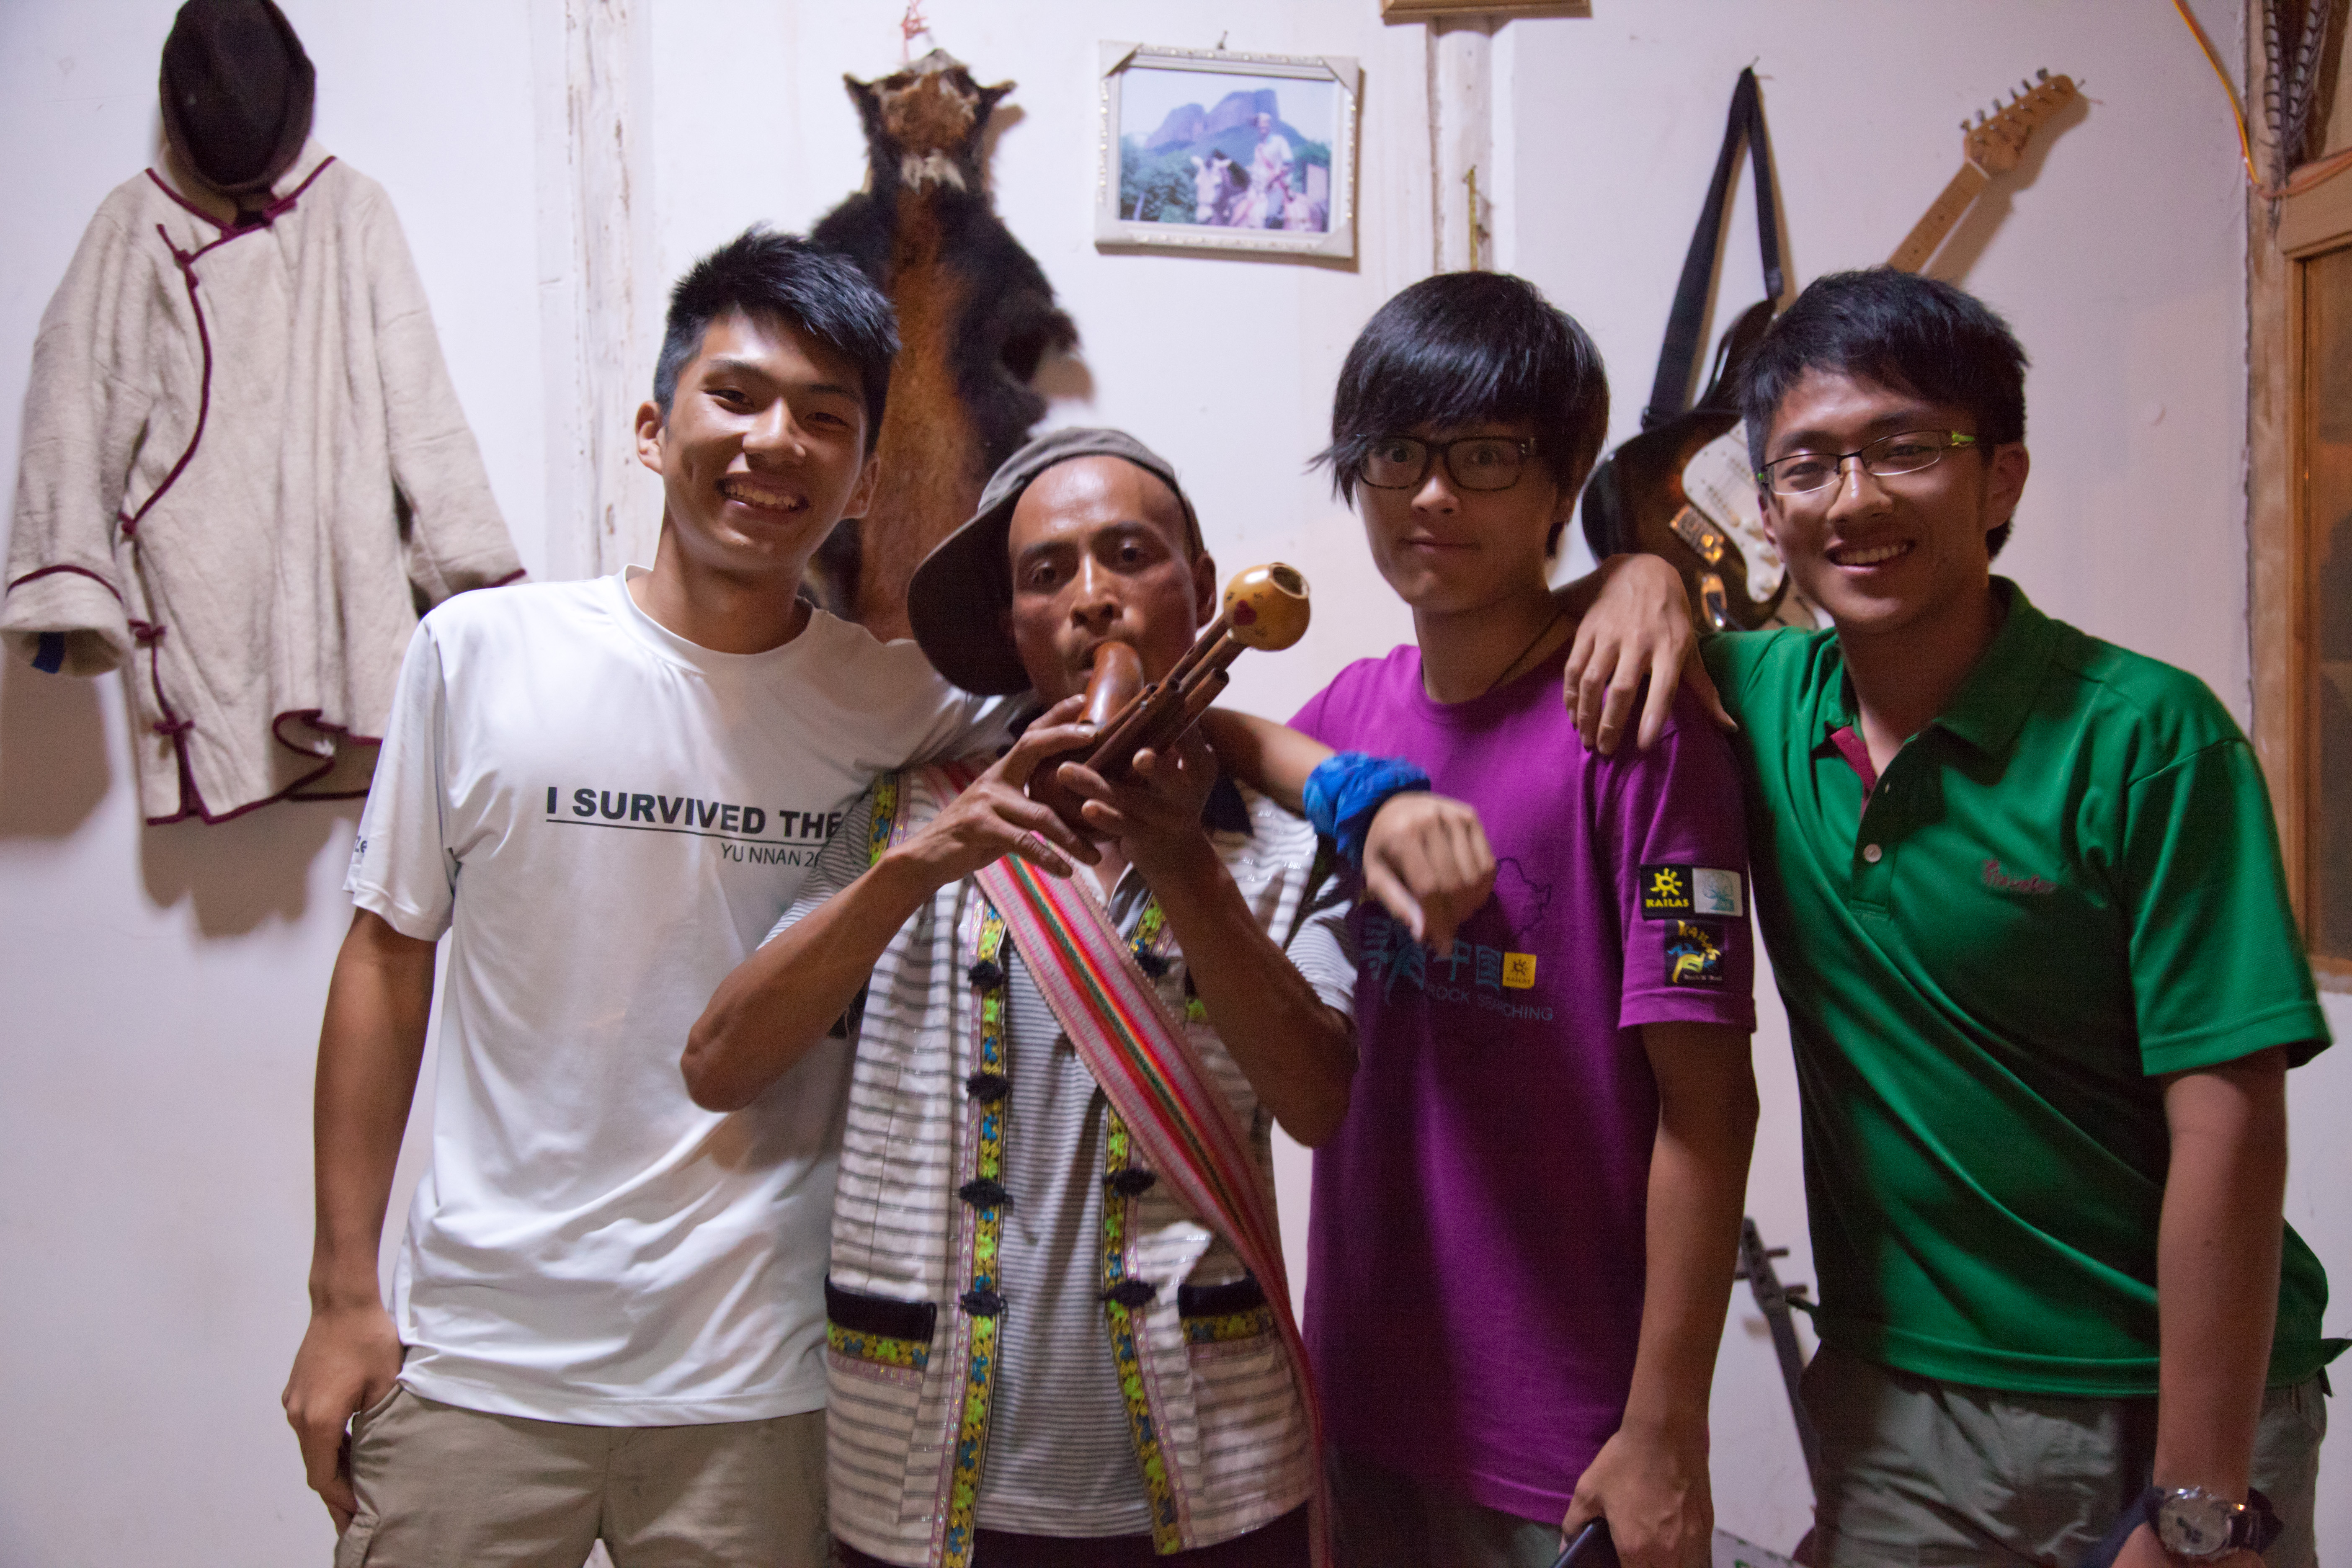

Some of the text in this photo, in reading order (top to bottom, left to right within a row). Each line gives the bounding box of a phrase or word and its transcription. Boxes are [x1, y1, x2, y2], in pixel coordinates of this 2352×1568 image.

[547, 787, 842, 838] I SURVIVED THE
[1645, 898, 1689, 908] KAILAS
[1426, 983, 1470, 1004] ROCK
